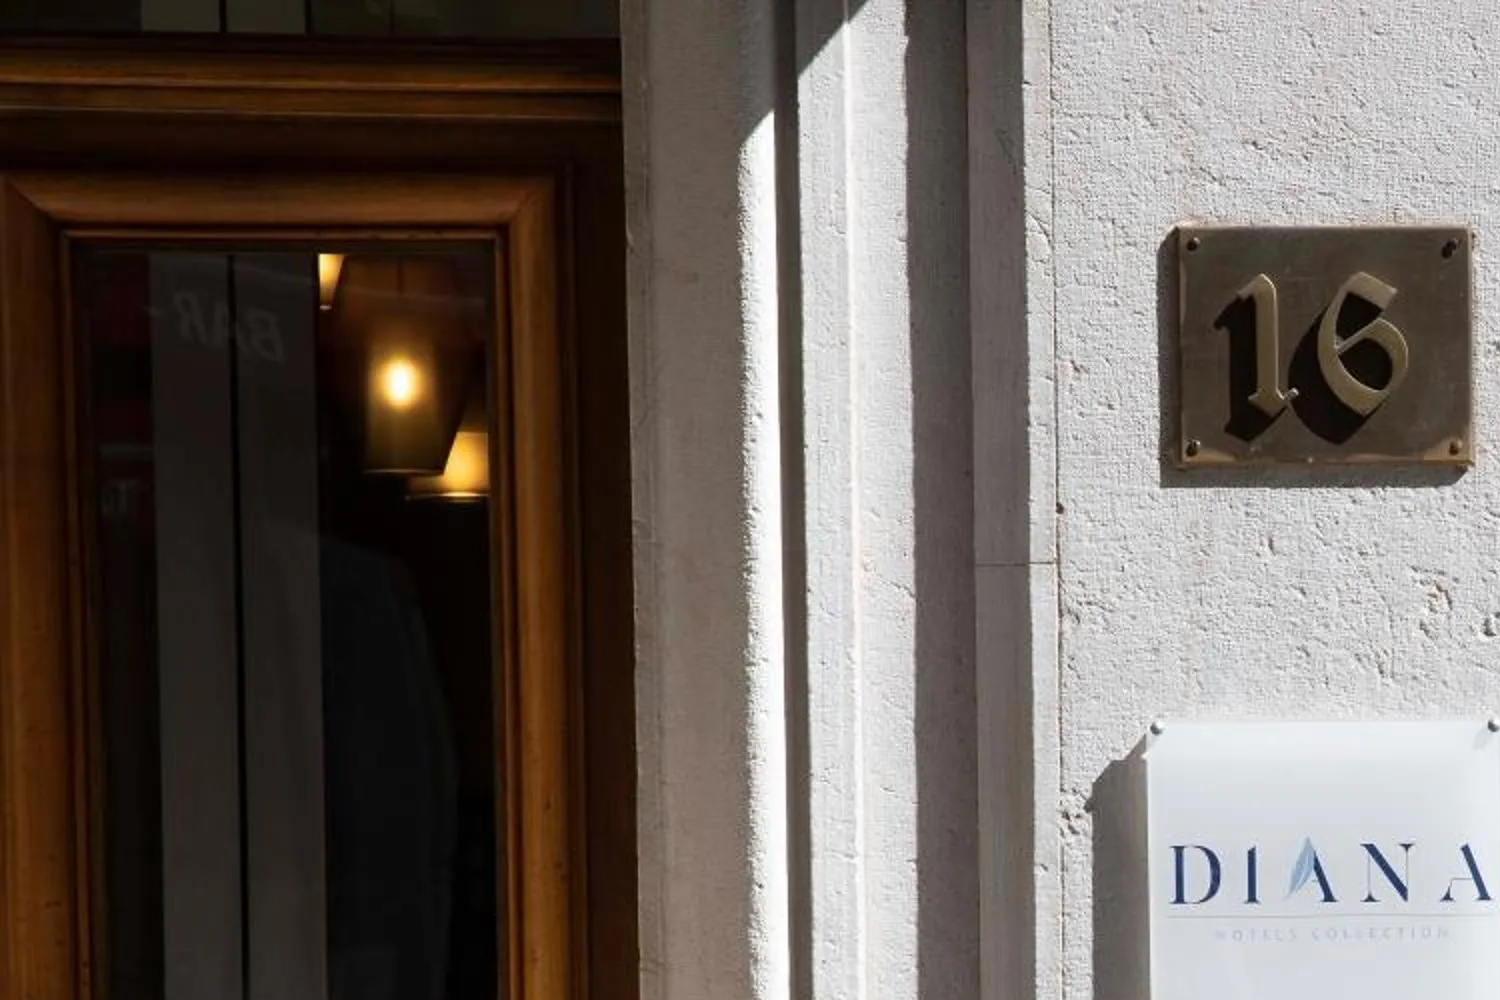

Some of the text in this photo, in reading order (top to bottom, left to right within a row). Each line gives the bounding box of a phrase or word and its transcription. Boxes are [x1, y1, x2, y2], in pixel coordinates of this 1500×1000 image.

[1236, 271, 1410, 419] 16
[1168, 837, 1494, 905] DIANA
[1213, 926, 1450, 943] HOTELS COLLECTION
